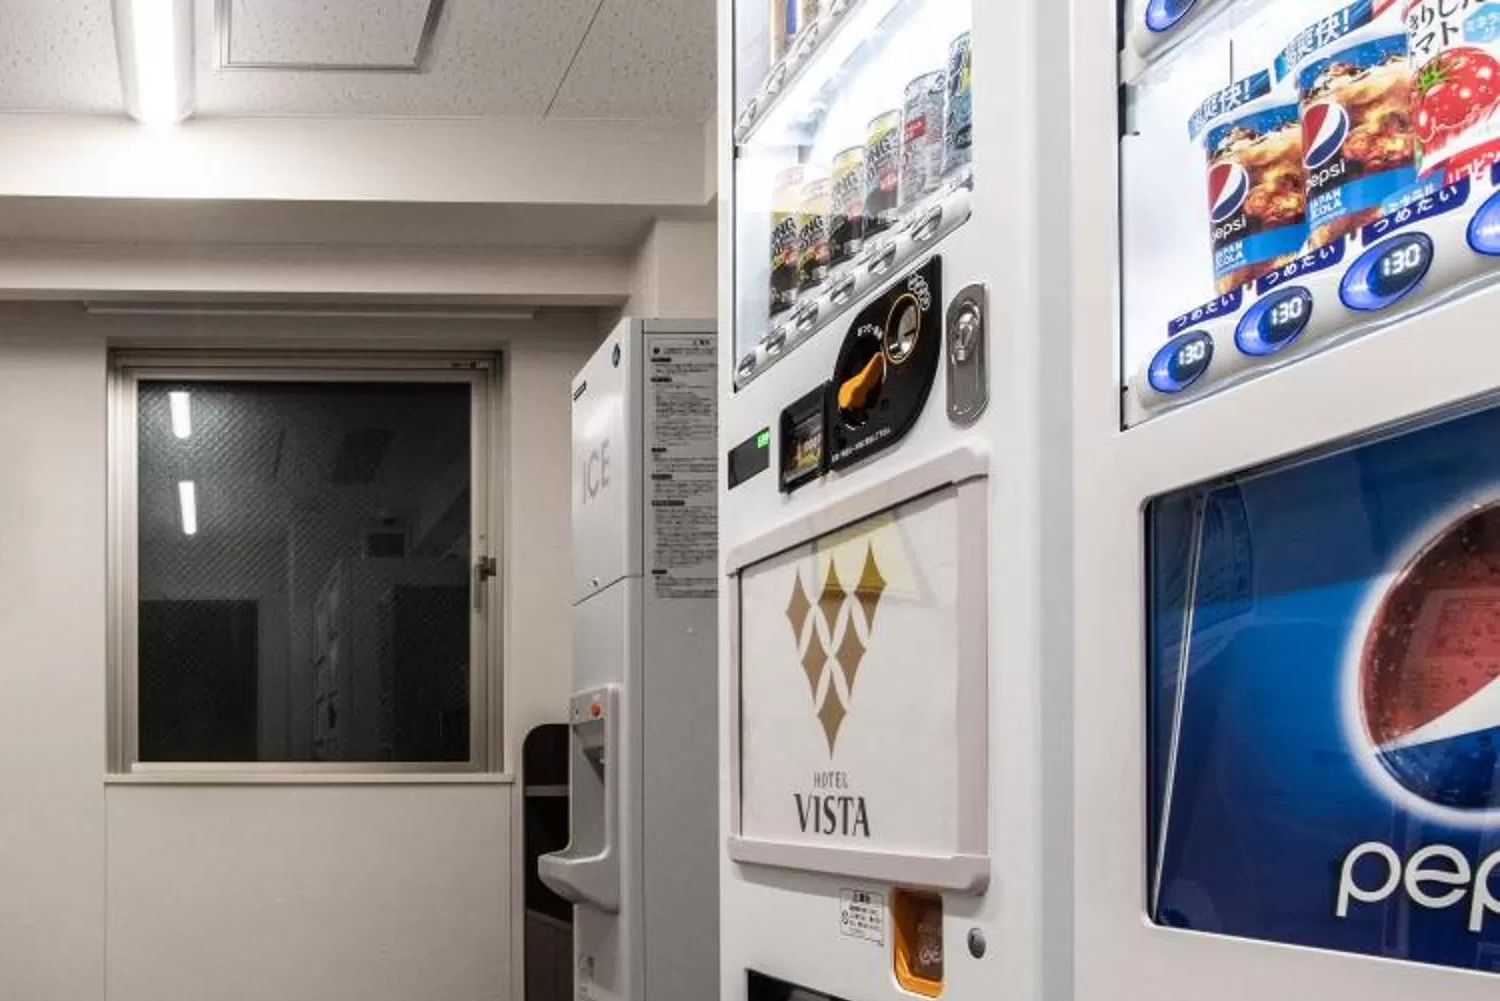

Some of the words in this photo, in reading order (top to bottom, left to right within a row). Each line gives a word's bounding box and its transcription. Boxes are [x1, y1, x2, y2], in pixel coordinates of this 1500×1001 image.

[1384, 243, 1420, 277] 130
[1271, 296, 1303, 324] 130
[1178, 340, 1206, 366] 130
[582, 438, 610, 505] ICE
[813, 770, 848, 790] HOTEL
[793, 793, 870, 838] VISTA
